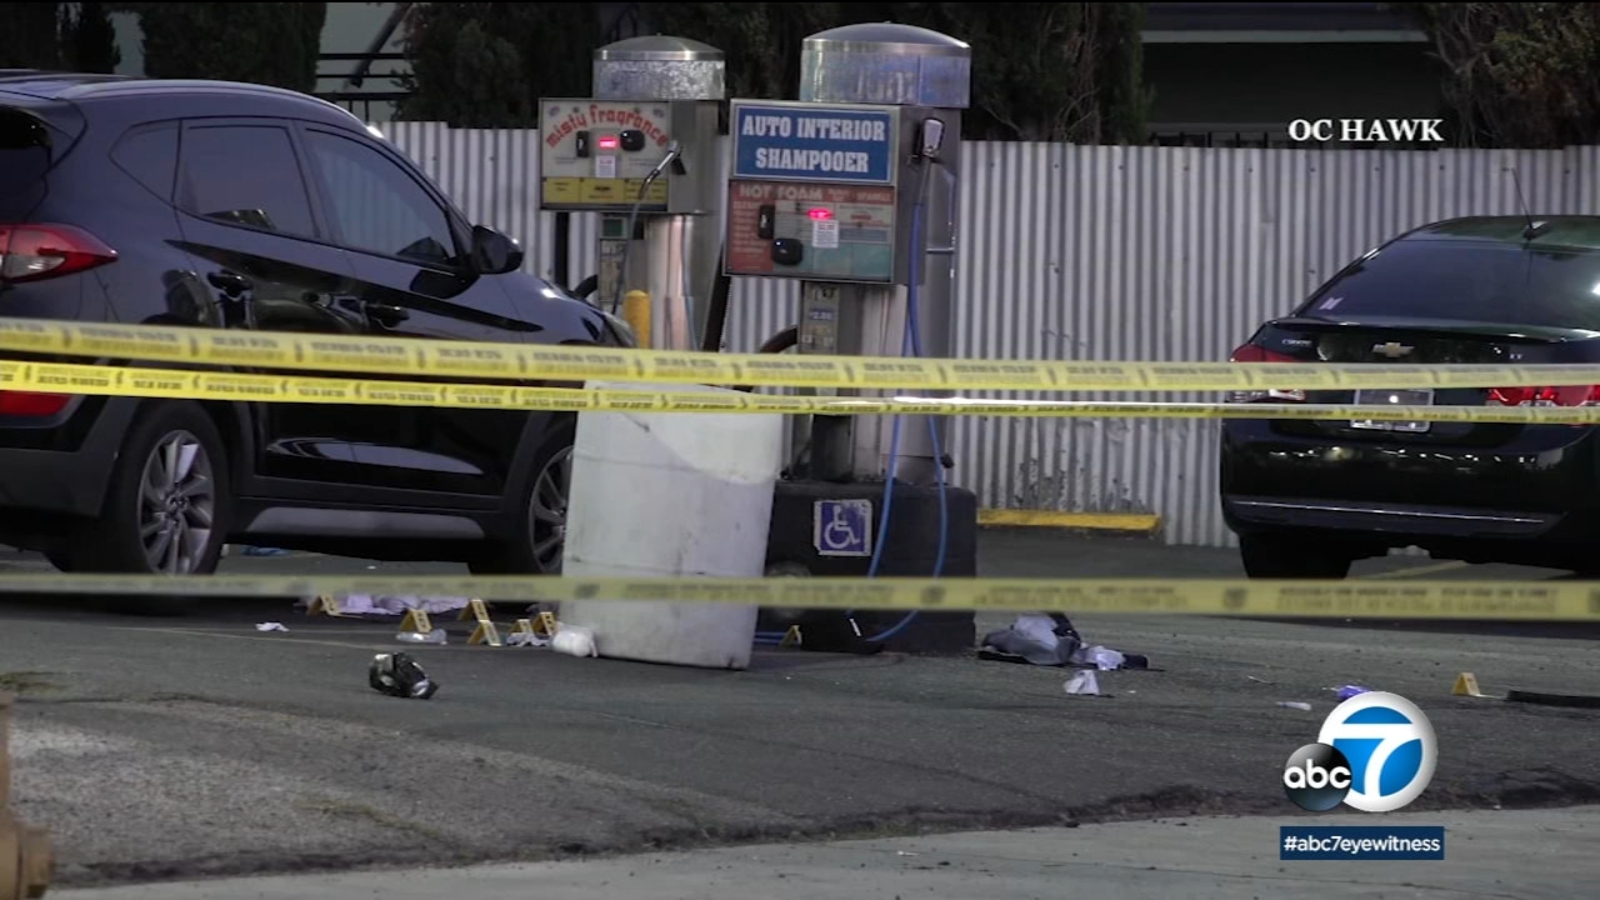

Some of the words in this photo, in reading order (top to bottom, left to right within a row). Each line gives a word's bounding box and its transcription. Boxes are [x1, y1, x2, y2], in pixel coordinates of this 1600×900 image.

[545, 111, 588, 148] misty
[589, 103, 669, 148] fragrance
[742, 115, 792, 137] AUTO
[796, 117, 886, 142] INTERIOR
[755, 147, 869, 174] SHAMPOOER
